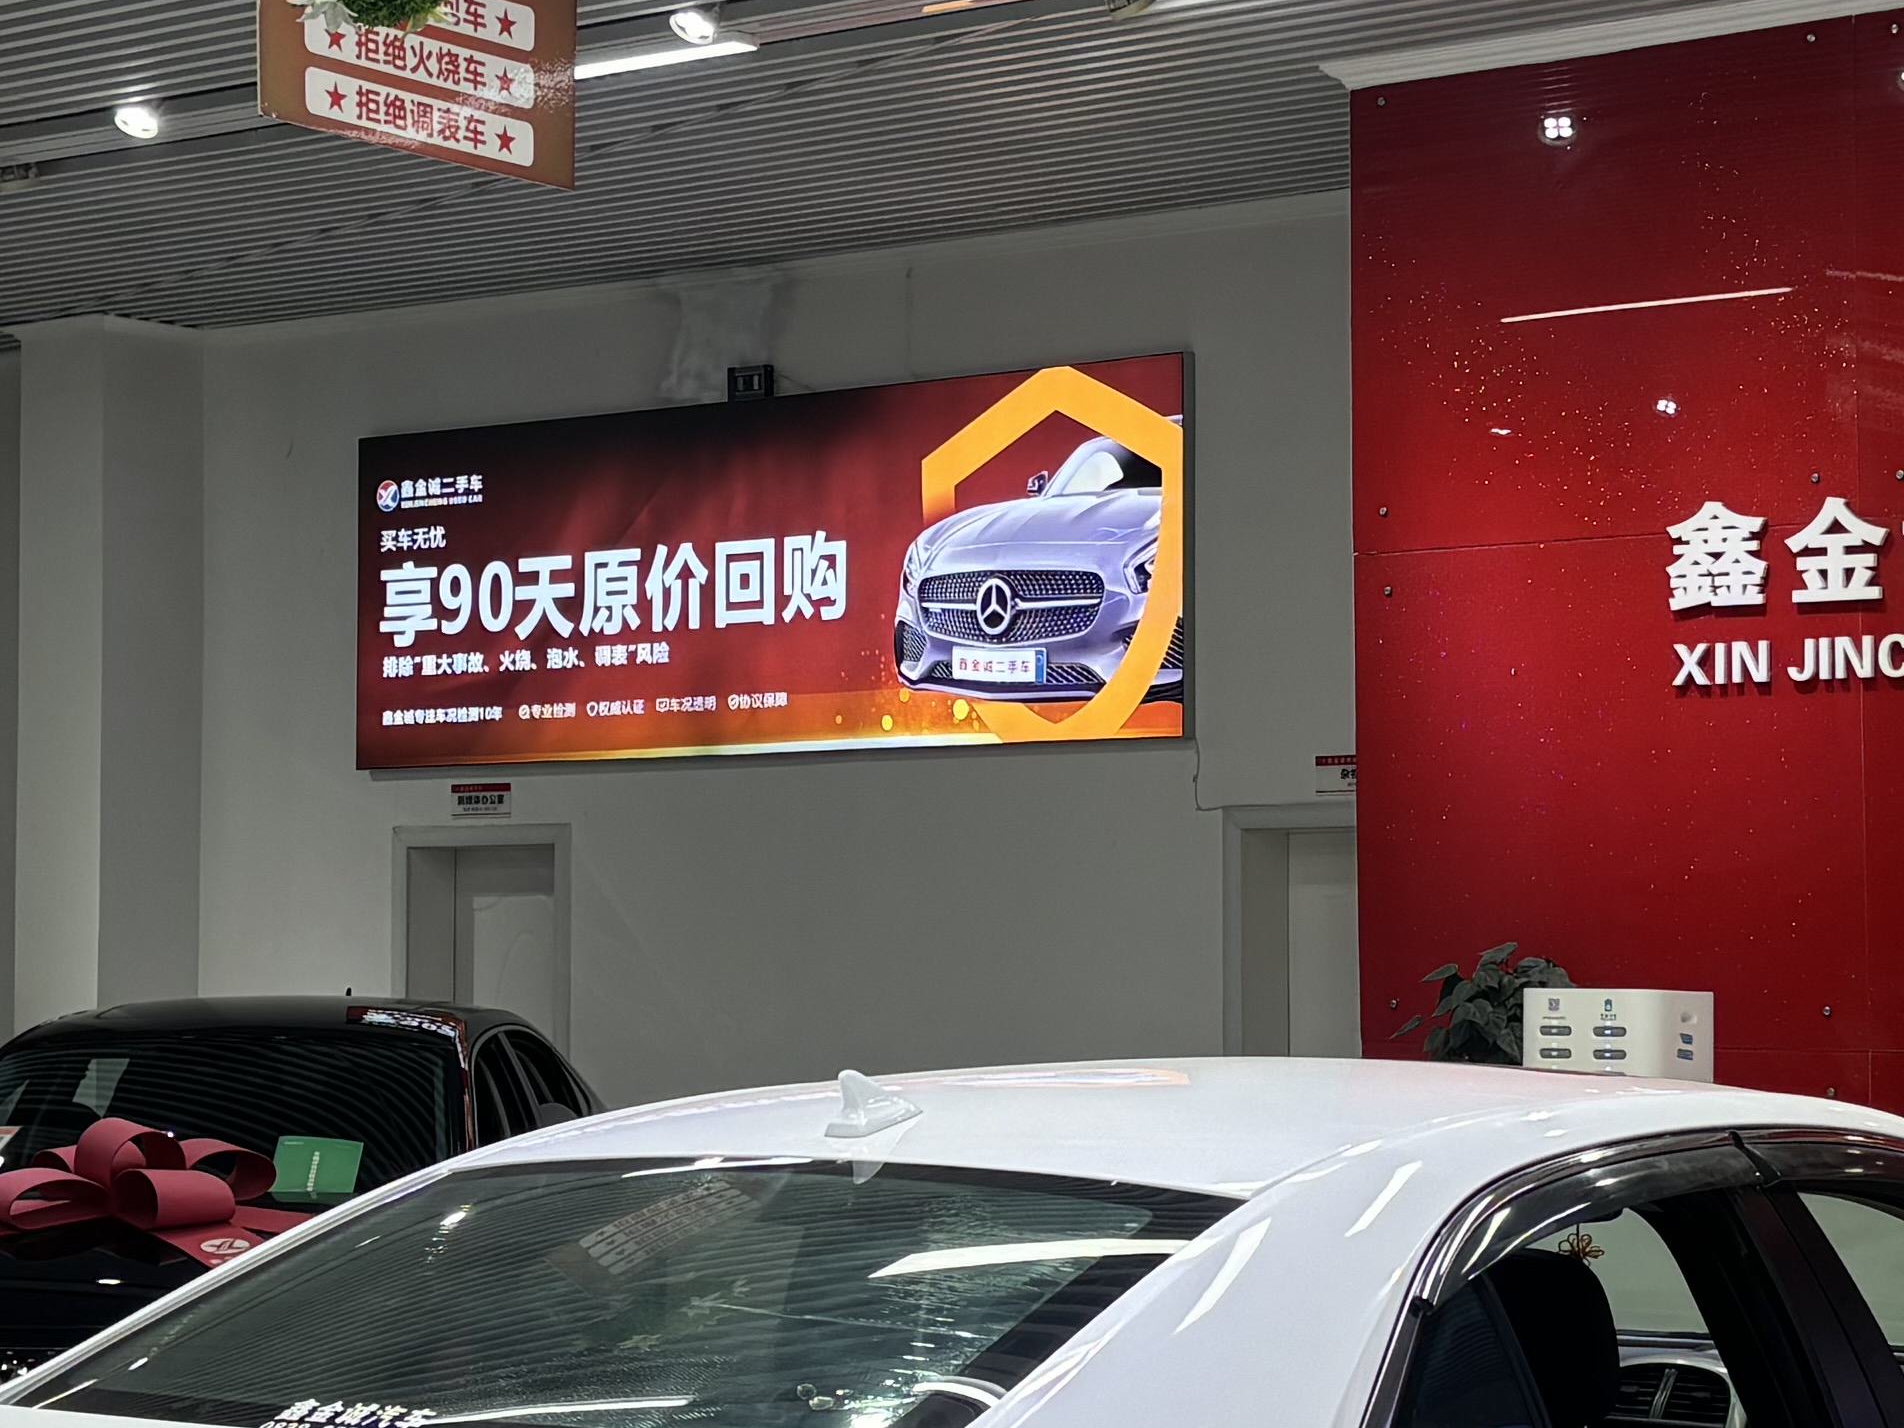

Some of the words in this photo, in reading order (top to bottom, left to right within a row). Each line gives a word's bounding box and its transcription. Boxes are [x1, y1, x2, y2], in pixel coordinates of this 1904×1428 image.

[356, 29, 487, 91] 拒绝火烧车
[356, 85, 487, 150] 拒绝调表车
[400, 474, 483, 499] 鑫金诚二手车
[380, 526, 446, 552] 买车无忧
[378, 529, 848, 648] 享90天原价回购
[1672, 640, 1771, 687] XIN
